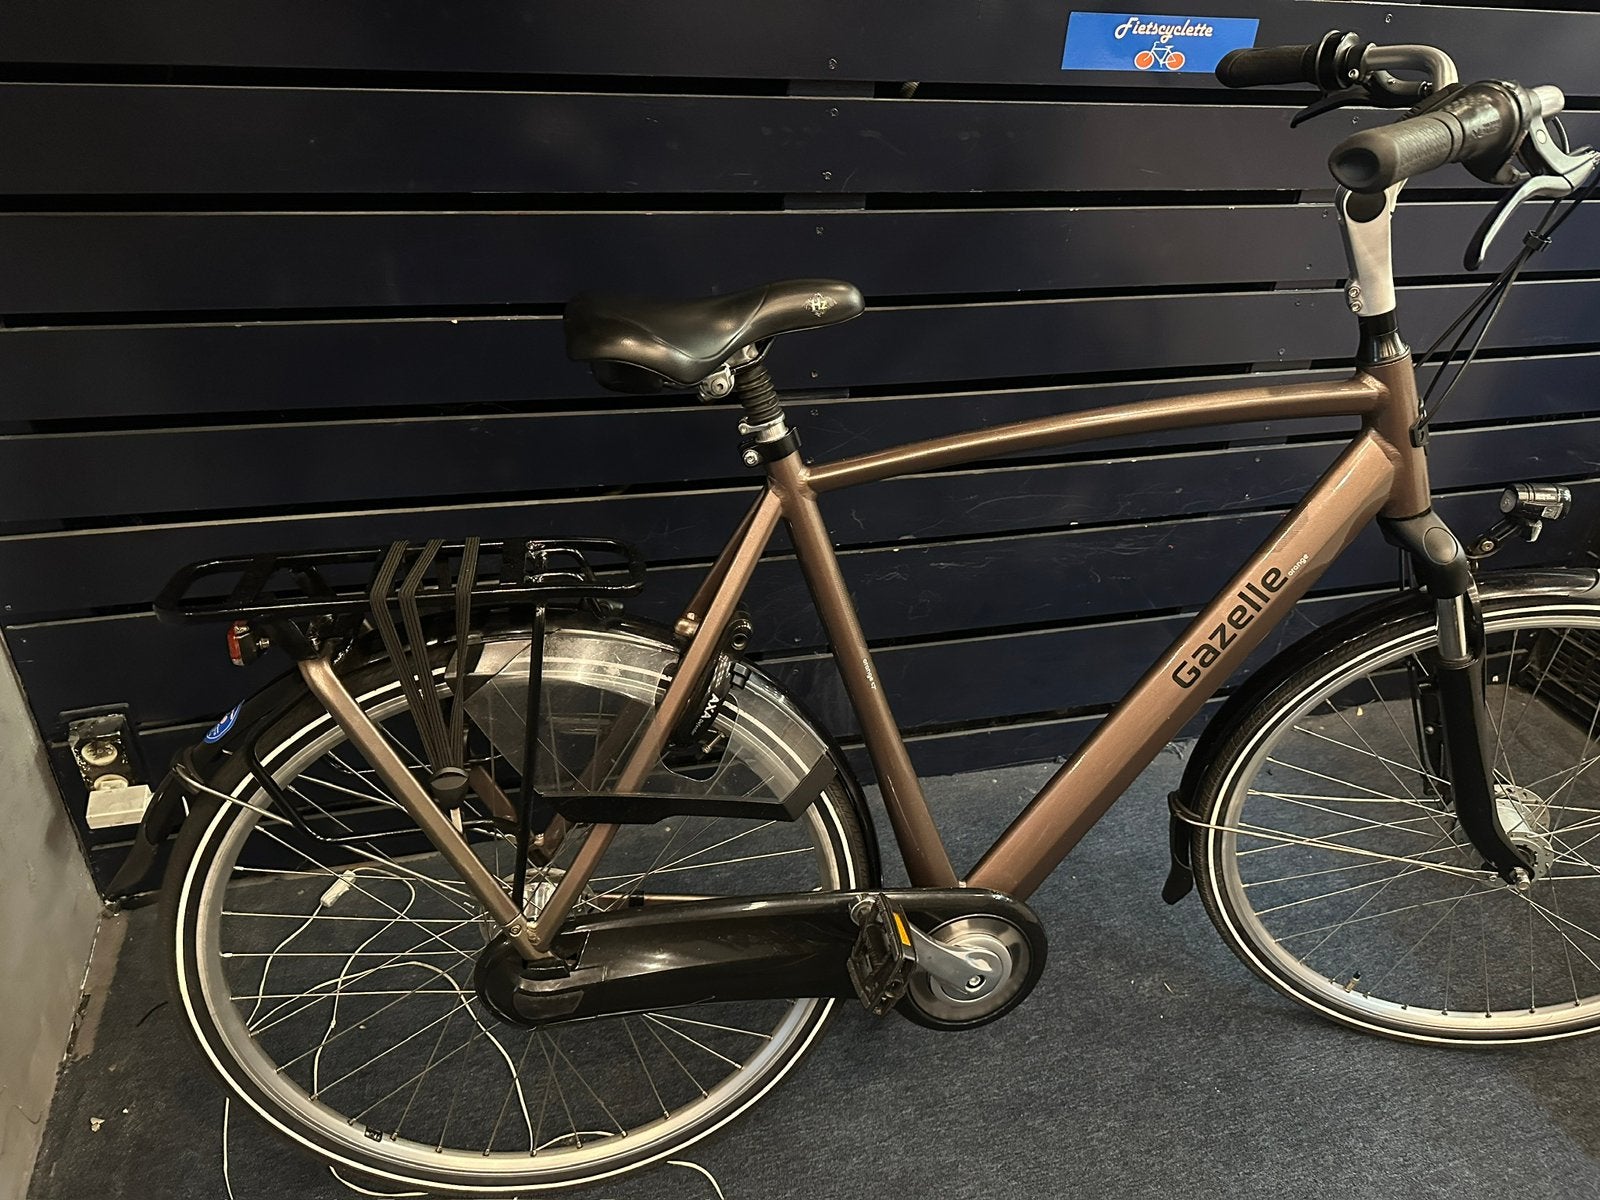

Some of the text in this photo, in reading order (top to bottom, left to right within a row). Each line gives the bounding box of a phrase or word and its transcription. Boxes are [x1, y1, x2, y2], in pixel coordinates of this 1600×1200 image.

[1114, 17, 1213, 43] Fietscyclette
[1171, 553, 1309, 689] Gazelle orange
[701, 693, 720, 719] AXA
